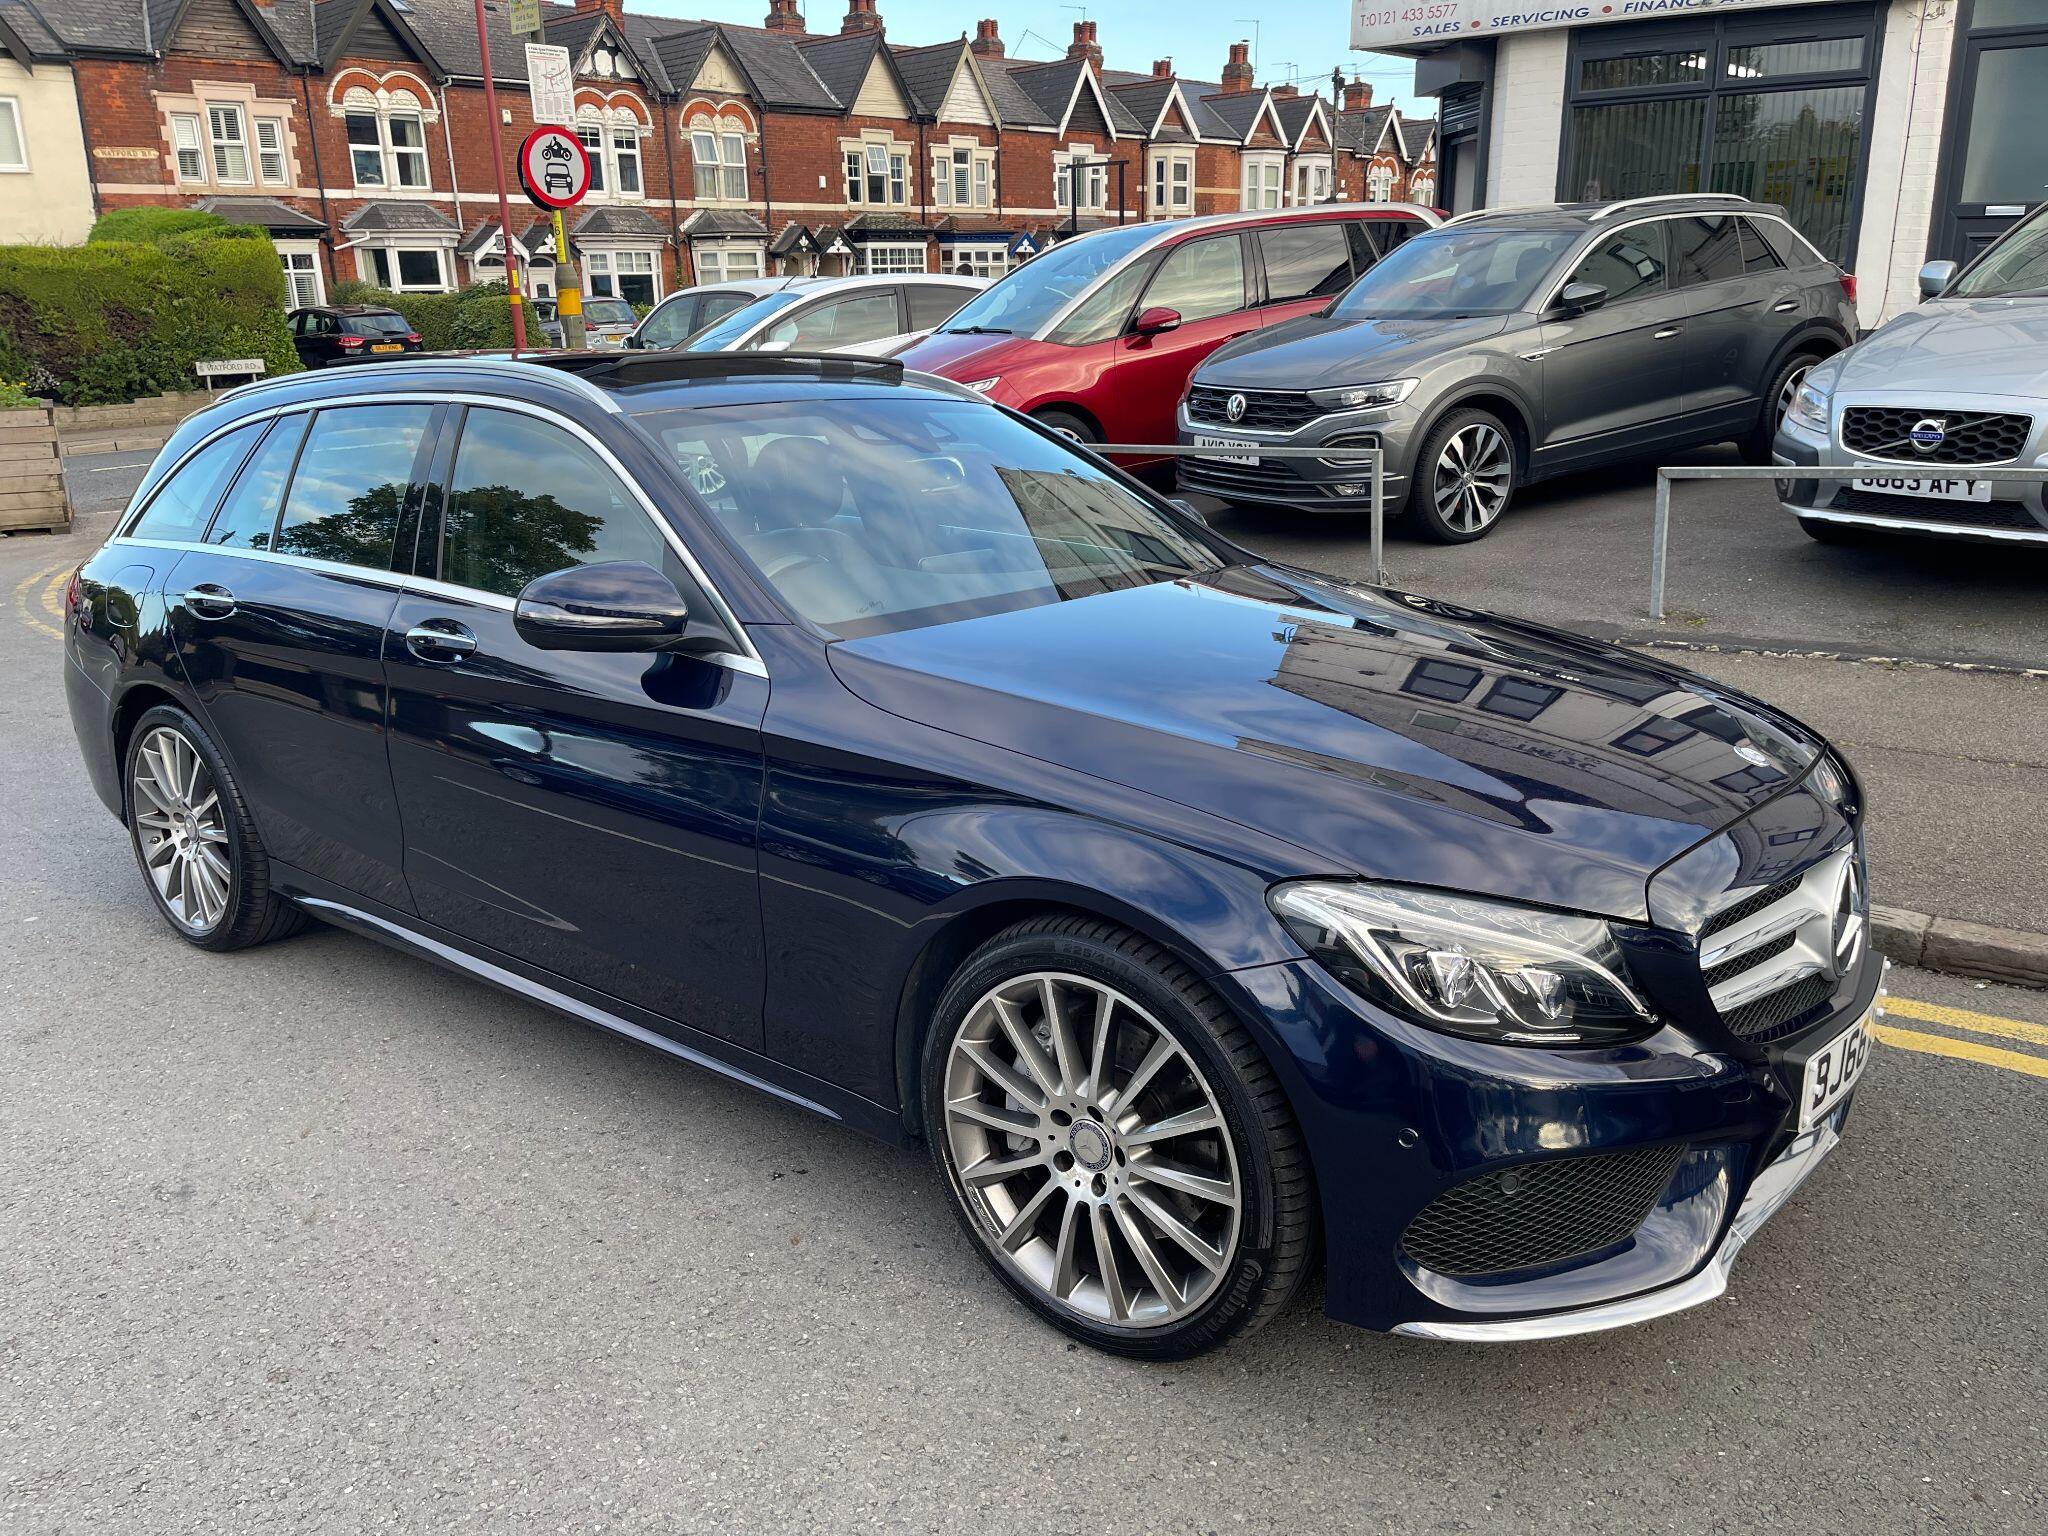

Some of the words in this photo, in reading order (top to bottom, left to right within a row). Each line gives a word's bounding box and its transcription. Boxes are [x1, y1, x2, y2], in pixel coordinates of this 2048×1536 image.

[1360, 11, 1396, 27] T:0121
[1402, 7, 1424, 22] 433
[1427, 3, 1458, 20] 5577
[1412, 21, 1461, 37] SALES
[1491, 7, 1590, 27] SERVICING
[206, 363, 243, 372] WATFORD
[244, 362, 257, 370] RD
[1912, 431, 1942, 440] VOLVO
